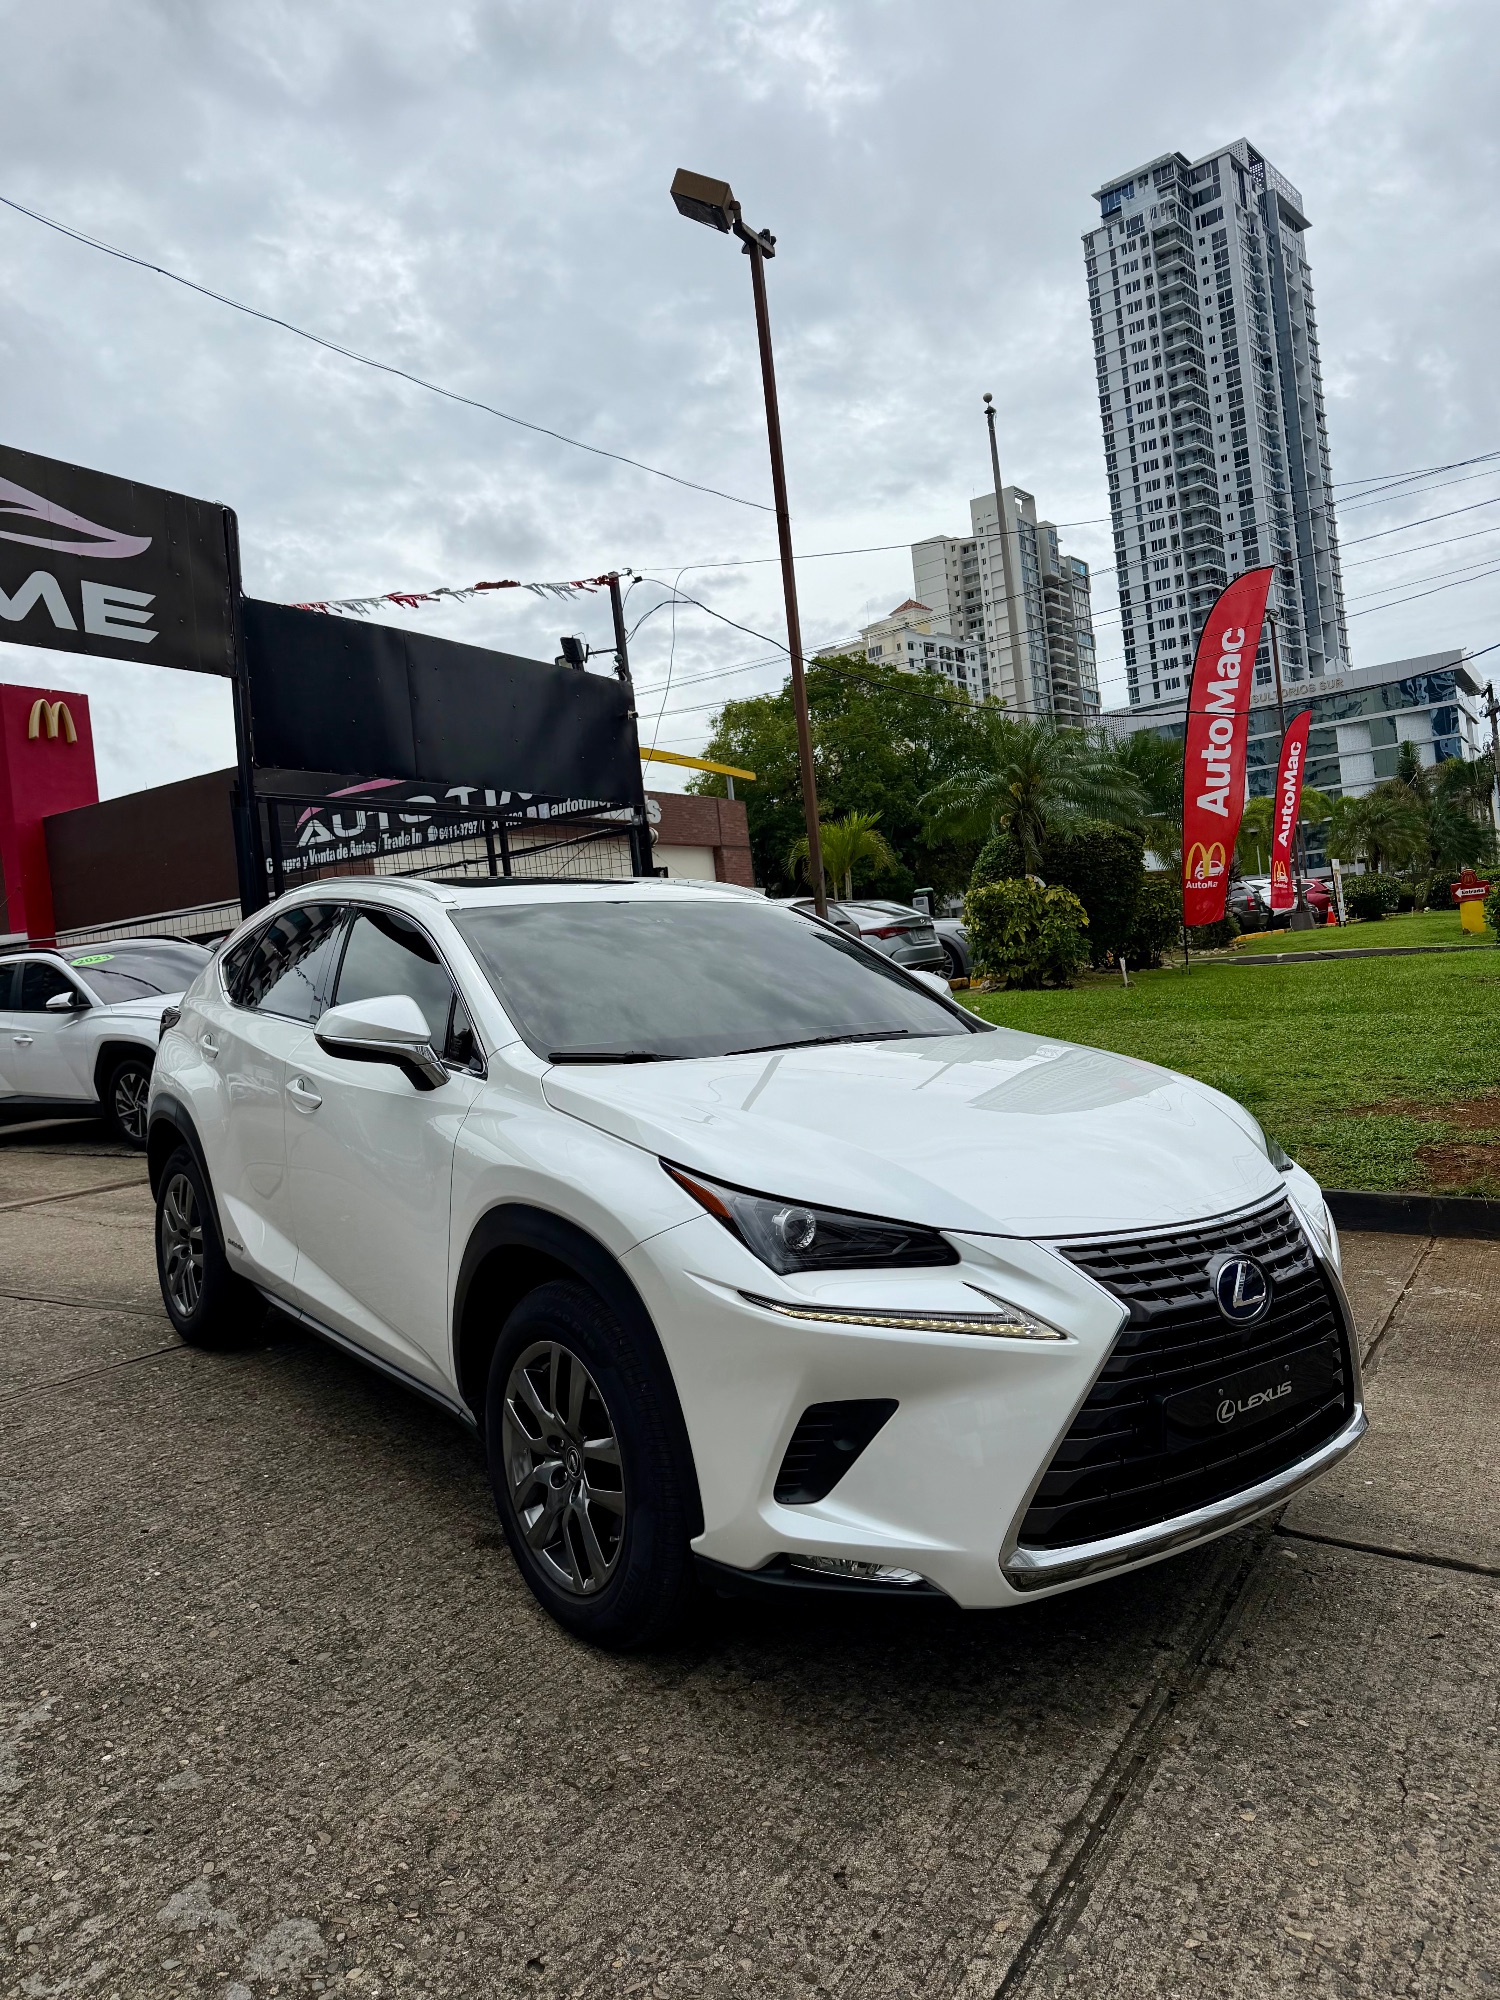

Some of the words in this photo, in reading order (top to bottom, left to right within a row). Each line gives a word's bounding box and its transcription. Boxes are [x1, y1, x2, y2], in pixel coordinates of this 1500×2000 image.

[1250, 684, 1316, 704] SULORIOS
[1320, 678, 1344, 691] SUR
[1197, 627, 1245, 818] AutoMac
[1278, 741, 1301, 848] AutoMac
[265, 857, 302, 874] Cmpra
[309, 848, 335, 865] Venta
[337, 843, 349, 860] de
[349, 839, 377, 857] Autos
[382, 832, 411, 851] Trade
[1238, 1381, 1292, 1413] LEXUS
